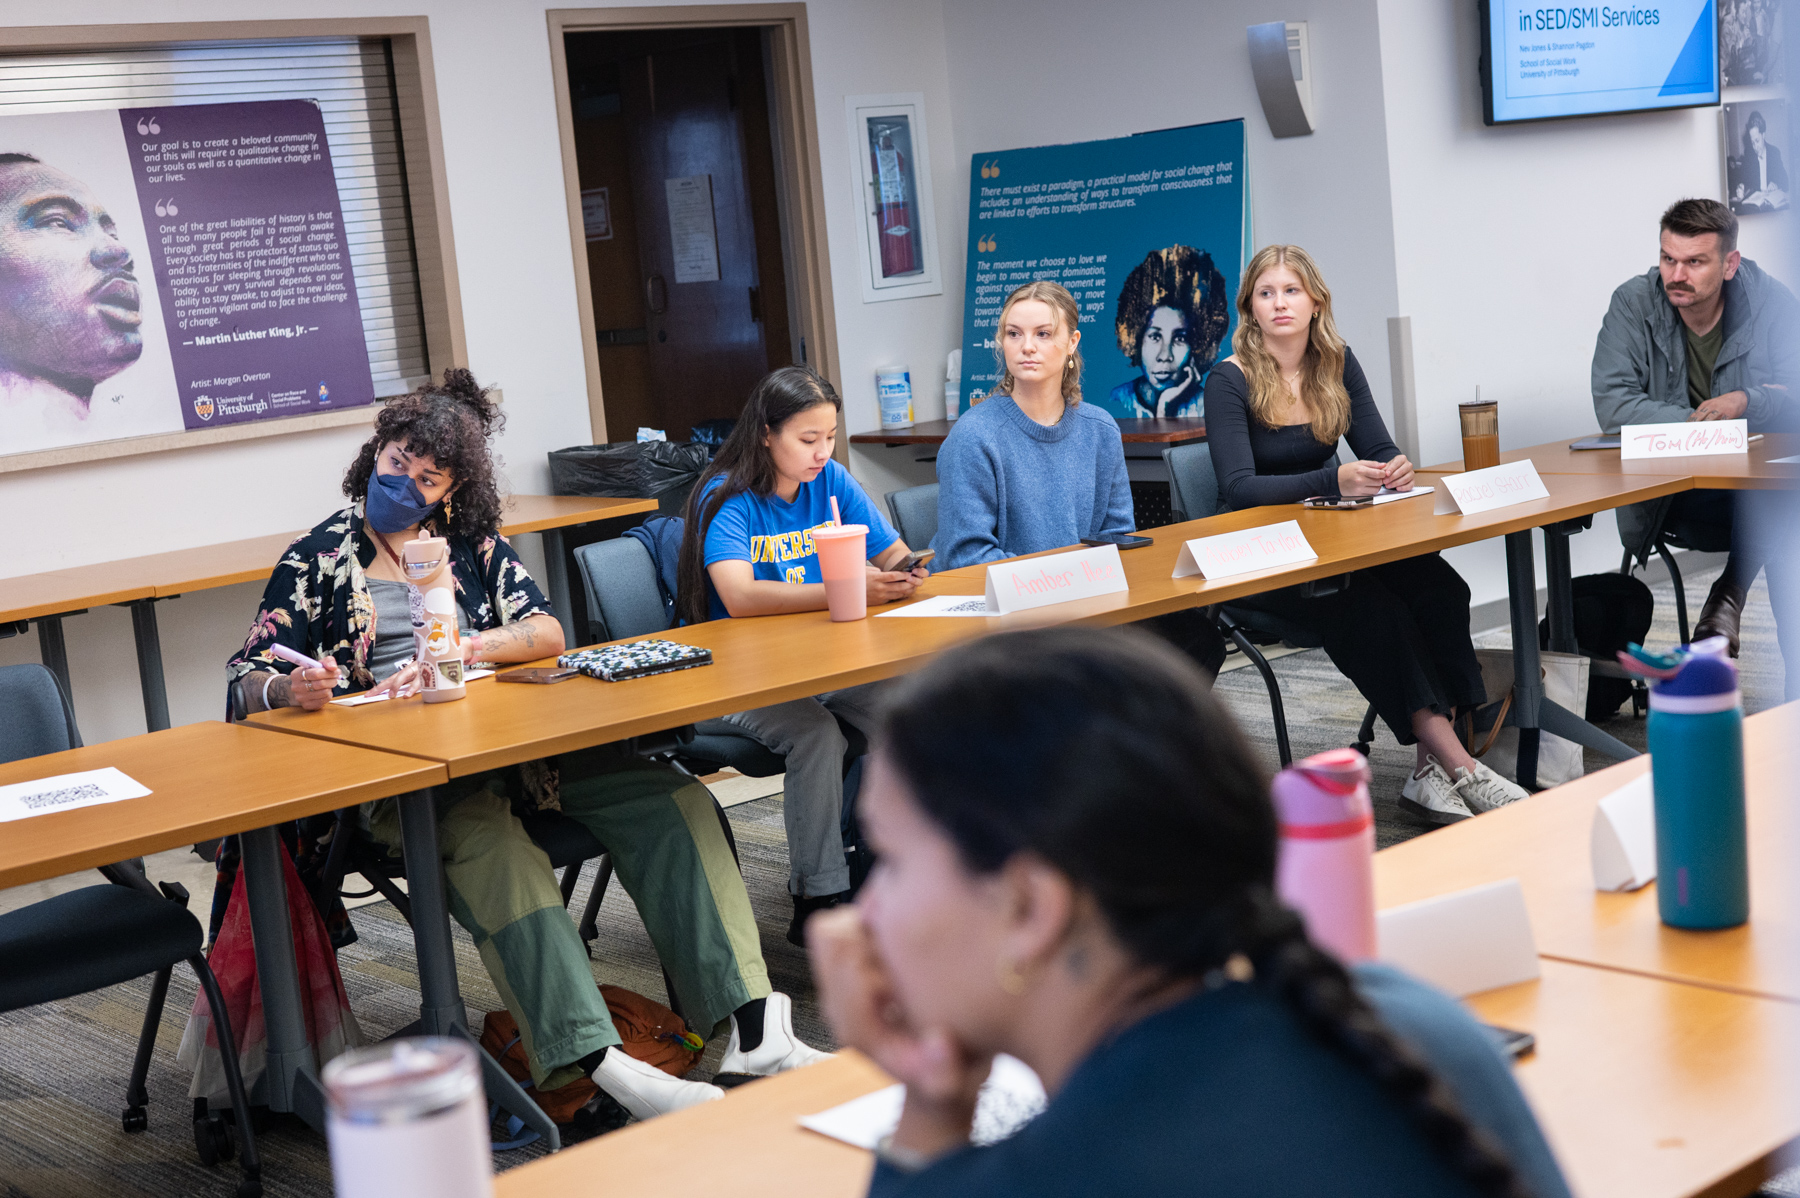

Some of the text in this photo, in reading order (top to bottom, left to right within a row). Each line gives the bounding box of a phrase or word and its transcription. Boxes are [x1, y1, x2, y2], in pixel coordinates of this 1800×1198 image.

[1520, 6, 1659, 31] in SED/SMI Services
[1520, 70, 1546, 79] University
[1554, 69, 1580, 77] Pittsburgh
[142, 143, 158, 152] Our
[161, 141, 179, 153] goal
[182, 141, 189, 149] is
[204, 139, 229, 147] create
[241, 135, 271, 145] beloved
[274, 133, 317, 146] community
[144, 153, 160, 162] and
[163, 152, 178, 161] this
[181, 150, 195, 159] will
[198, 149, 227, 161] require
[238, 146, 279, 158] qualitative
[281, 144, 309, 156] change
[311, 142, 319, 150] in
[163, 162, 184, 171] souls
[198, 159, 214, 169] well
[235, 156, 282, 168] quantitative
[284, 154, 311, 164] change
[165, 173, 186, 182] lives.
[981, 187, 1001, 196] There
[1002, 185, 1022, 194] must
[1023, 184, 1040, 193] exist
[1048, 180, 1085, 193] paradigm,
[1094, 174, 1126, 188] practical
[1127, 170, 1151, 182] model
[1151, 170, 1163, 182] for
[1164, 166, 1186, 178] social
[1187, 165, 1215, 176] change
[1216, 162, 1233, 172] that
[980, 198, 1010, 208] includes
[1025, 190, 1078, 205] understanding
[1080, 189, 1090, 201] of
[1091, 189, 1109, 200] ways
[1111, 188, 1120, 196] to
[1122, 183, 1158, 196] transform
[1161, 177, 1213, 191] consciousness
[1216, 174, 1233, 184] that
[979, 198, 1136, 219] are linked to efforts to transform structures.
[159, 211, 332, 234] One of the great liabilities of history is that
[166, 243, 338, 267] Every society has its protectors of status quo
[978, 261, 990, 270] The
[993, 260, 1024, 269] moment
[1040, 257, 1066, 267] choose
[1068, 256, 1076, 265] to
[1078, 255, 1094, 264] love
[170, 263, 341, 286] notorious for sleeping through revolutions.
[976, 266, 1106, 284] begin to move against domination,
[976, 284, 1002, 295] against
[1064, 280, 1093, 288] moment
[175, 297, 200, 307] ability
[212, 295, 229, 305] stay
[231, 291, 258, 304] awake,
[270, 287, 294, 300] adjust
[324, 283, 346, 295] ideas,
[975, 295, 1000, 304] choose
[1074, 290, 1105, 299] to move
[188, 306, 217, 316] remain
[219, 303, 248, 314] vigilant
[251, 300, 266, 310] and
[279, 298, 295, 309] face
[298, 296, 310, 305] the
[312, 293, 348, 303] challenge
[1086, 302, 1104, 312] ways
[974, 318, 990, 327] that
[196, 325, 307, 346] Martin Luther King, Jr.
[191, 372, 270, 389] Artist: Morgan Overton
[216, 395, 246, 404] University
[218, 399, 268, 416] Pittsburgh
[1206, 532, 1302, 566] Abbey Taylor
[786, 566, 805, 584] OF
[1012, 569, 1074, 596] Amber
